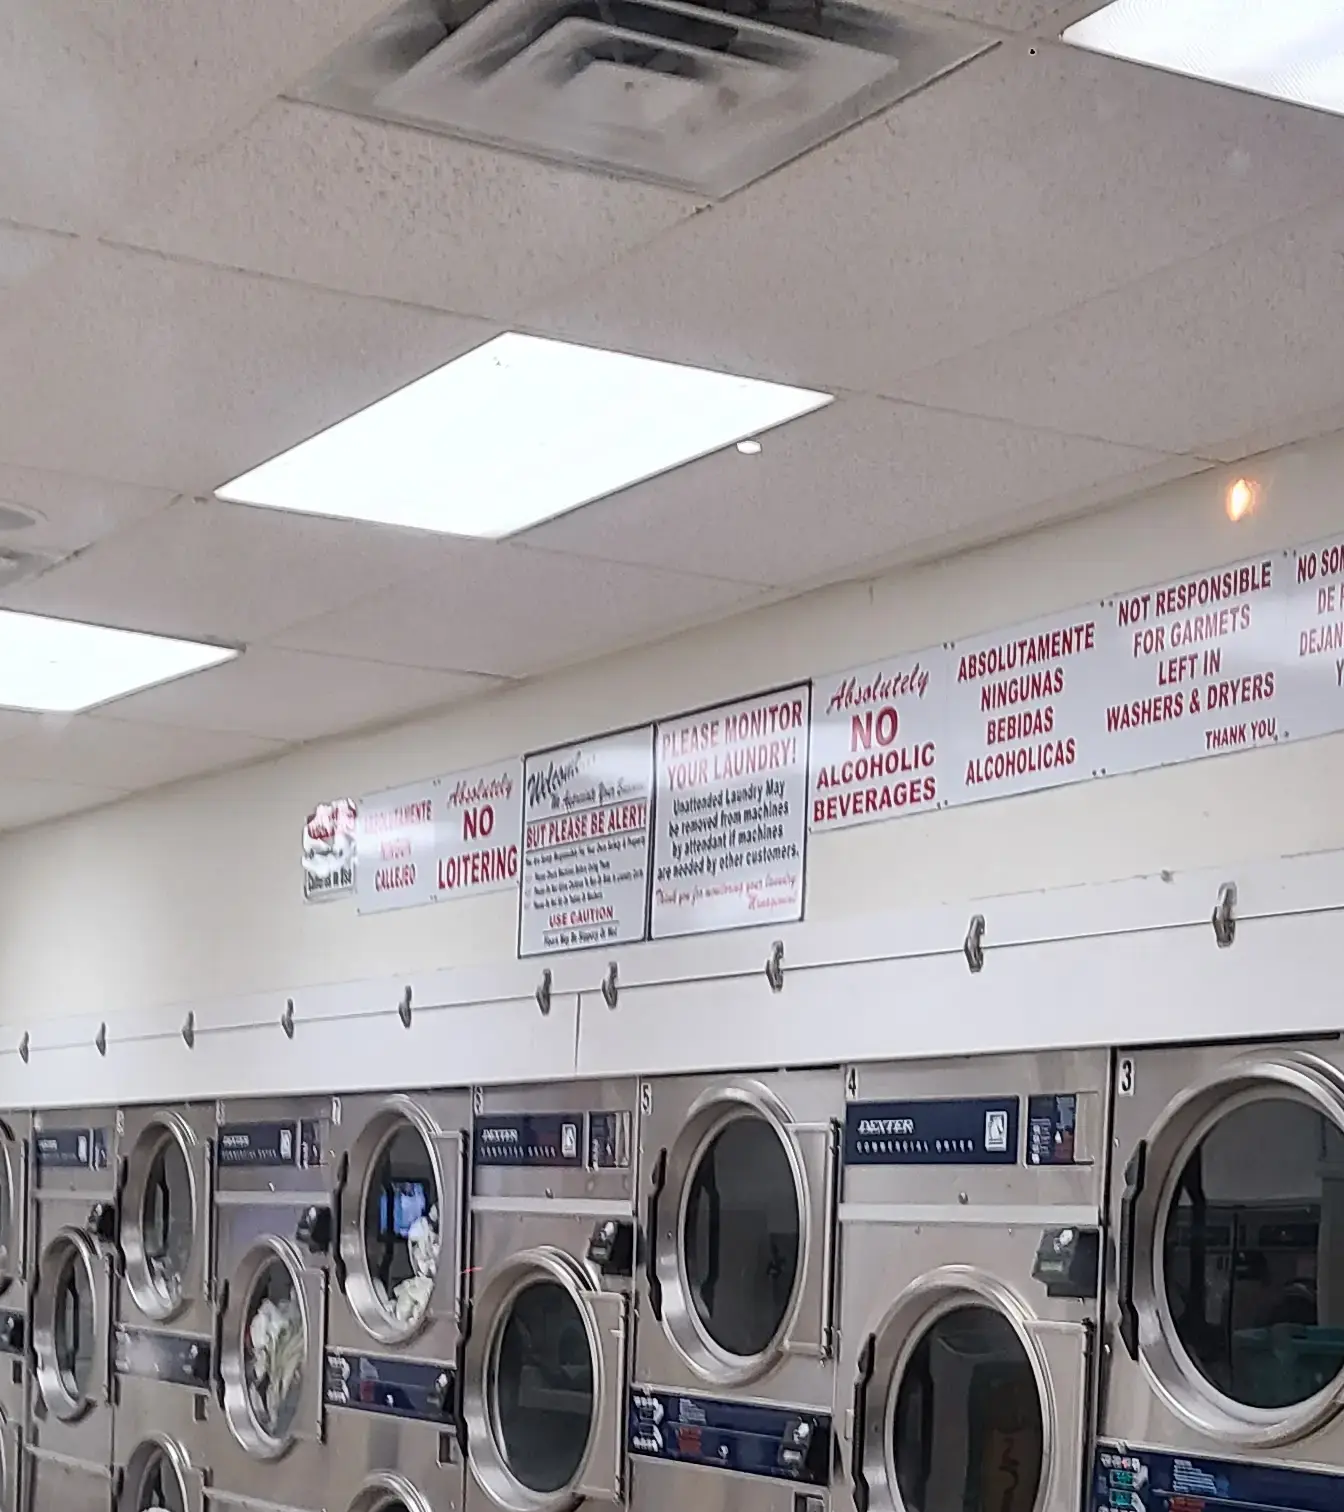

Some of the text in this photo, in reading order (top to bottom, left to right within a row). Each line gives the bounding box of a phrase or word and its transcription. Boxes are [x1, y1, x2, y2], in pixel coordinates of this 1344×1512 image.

[1297, 552, 1317, 584] NO
[1118, 560, 1272, 627] NOT RESPONSIBLE
[1317, 586, 1336, 615] DE
[957, 621, 1095, 684] ABSOLUTAMENTE
[1133, 603, 1251, 659] FOR GARMETS
[826, 662, 930, 715] Absolutely
[1158, 647, 1221, 686] LEFT IN
[1336, 658, 1344, 687] Y
[981, 667, 1064, 713] NINGUNAS
[1106, 671, 1274, 733] WASHERS & DRYERS
[662, 700, 803, 762] PLEASE MONITOR
[851, 705, 899, 752] NO
[987, 705, 1054, 746] BEBIDAS
[1205, 723, 1247, 750] THANK
[667, 759, 708, 792] YOUR
[714, 737, 796, 781] LAUNDRY!
[816, 741, 935, 790] ALCOHOLIC
[965, 737, 1076, 786] ALCOHOLICAS
[725, 782, 763, 805] Laundry
[765, 778, 785, 799] May
[743, 800, 789, 822] machines
[814, 776, 936, 823] BEVERAGES
[463, 804, 494, 841] NO
[526, 803, 646, 849] BUT PLEASE BE ALERT!
[738, 823, 783, 845] machines
[438, 844, 518, 890] LOITERING
[549, 905, 613, 928] USE CAUTION
[848, 1067, 856, 1098] 4
[1122, 1060, 1131, 1091] 3
